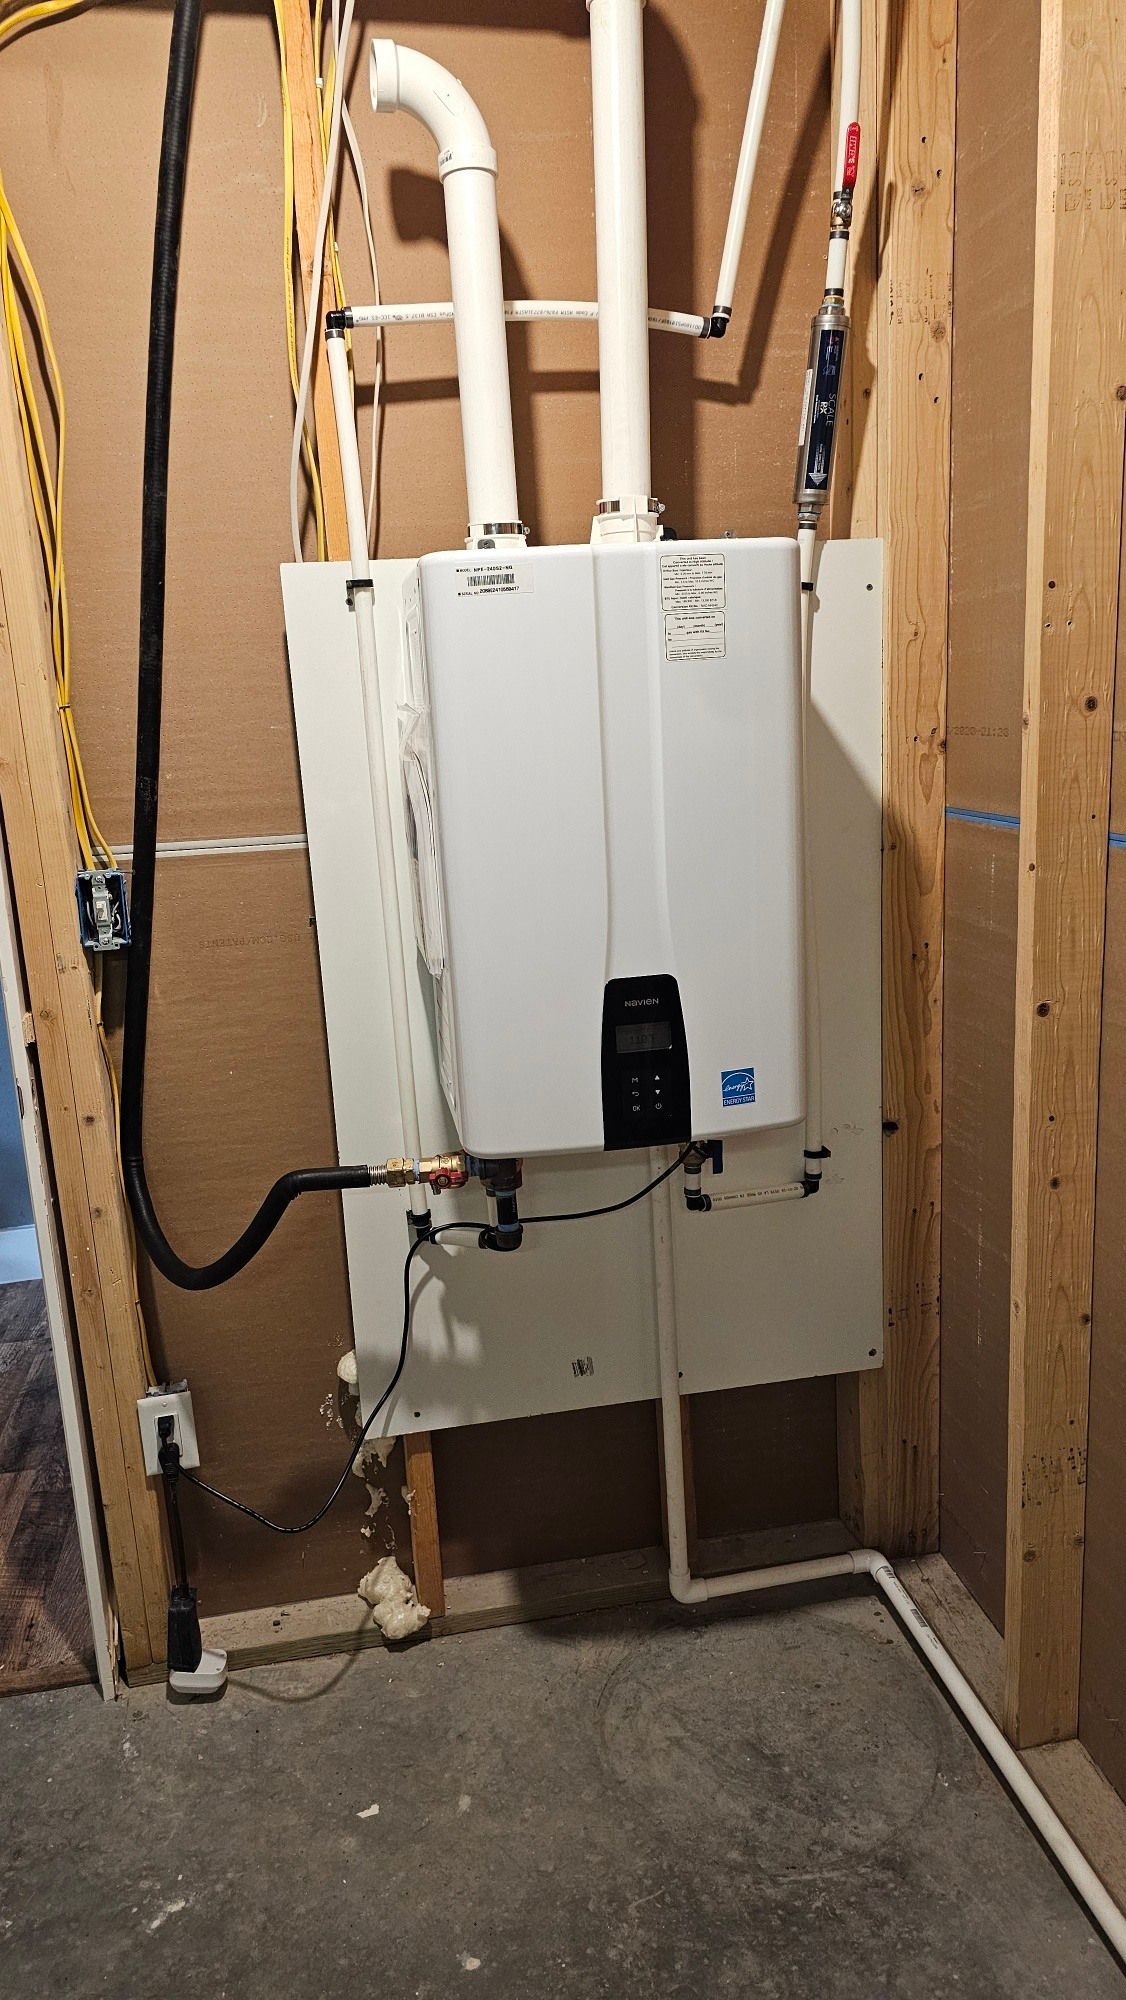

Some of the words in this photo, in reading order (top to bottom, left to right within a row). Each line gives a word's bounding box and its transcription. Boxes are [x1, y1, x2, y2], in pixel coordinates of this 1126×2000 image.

[825, 392, 837, 427] SCALE
[723, 1098, 742, 1106] ENERGY
[742, 1095, 755, 1103] STAR
